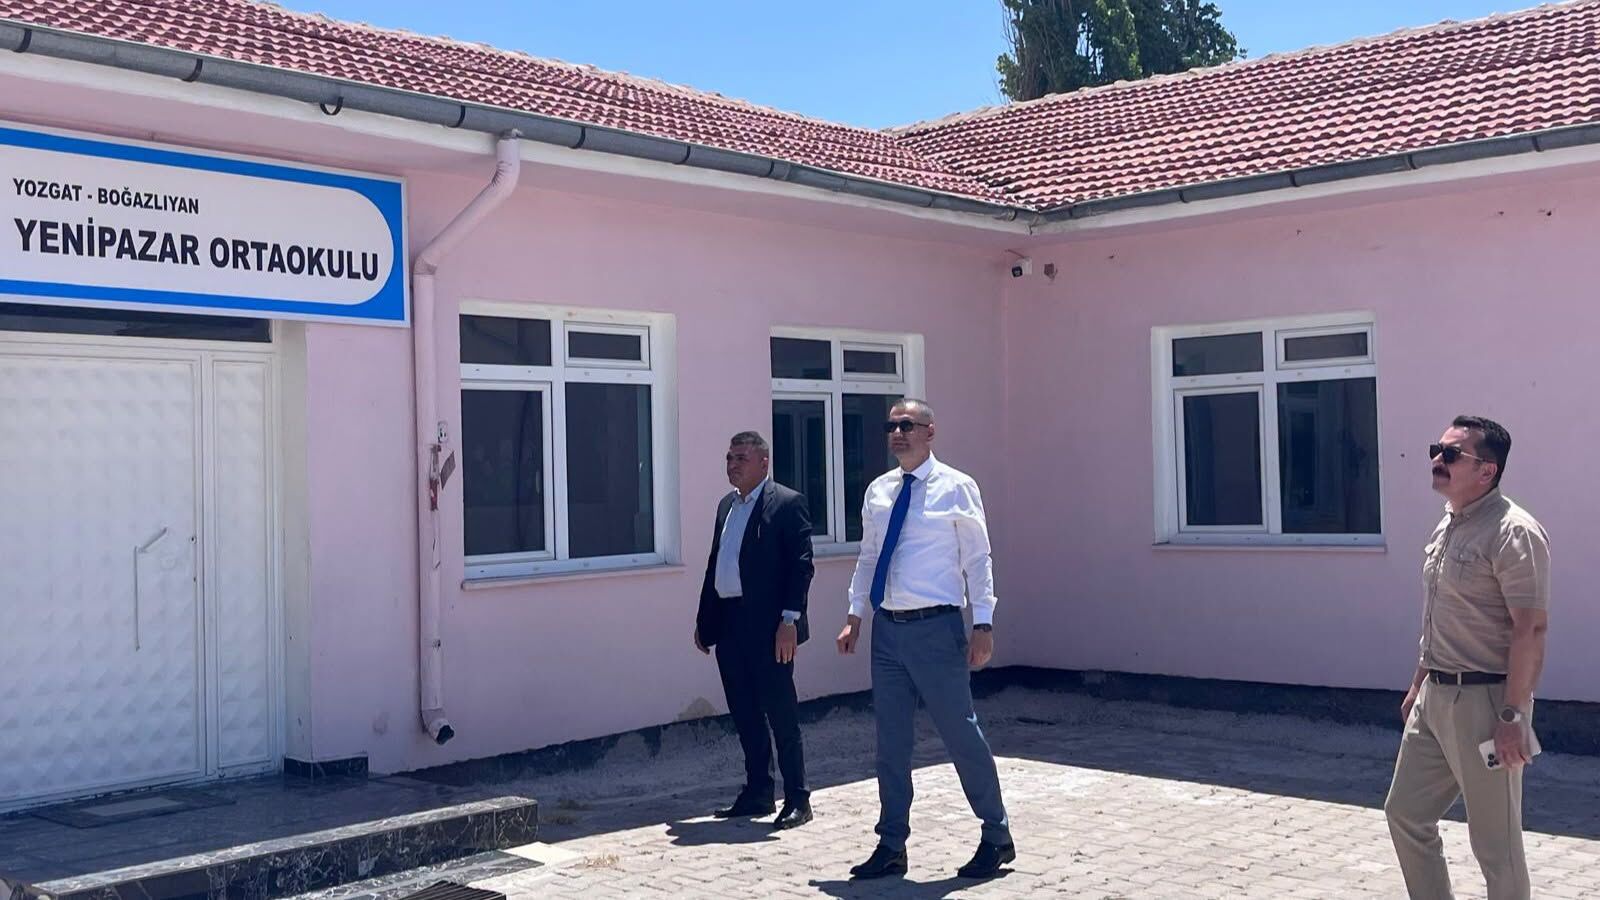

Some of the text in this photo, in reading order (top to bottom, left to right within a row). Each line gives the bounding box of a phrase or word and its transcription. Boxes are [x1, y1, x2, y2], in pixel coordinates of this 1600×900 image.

[13, 178, 82, 202] YOZGAT
[98, 187, 199, 215] BOĞAZLIYAN
[14, 217, 379, 281] YENİPAZAR ORTAOKULU
